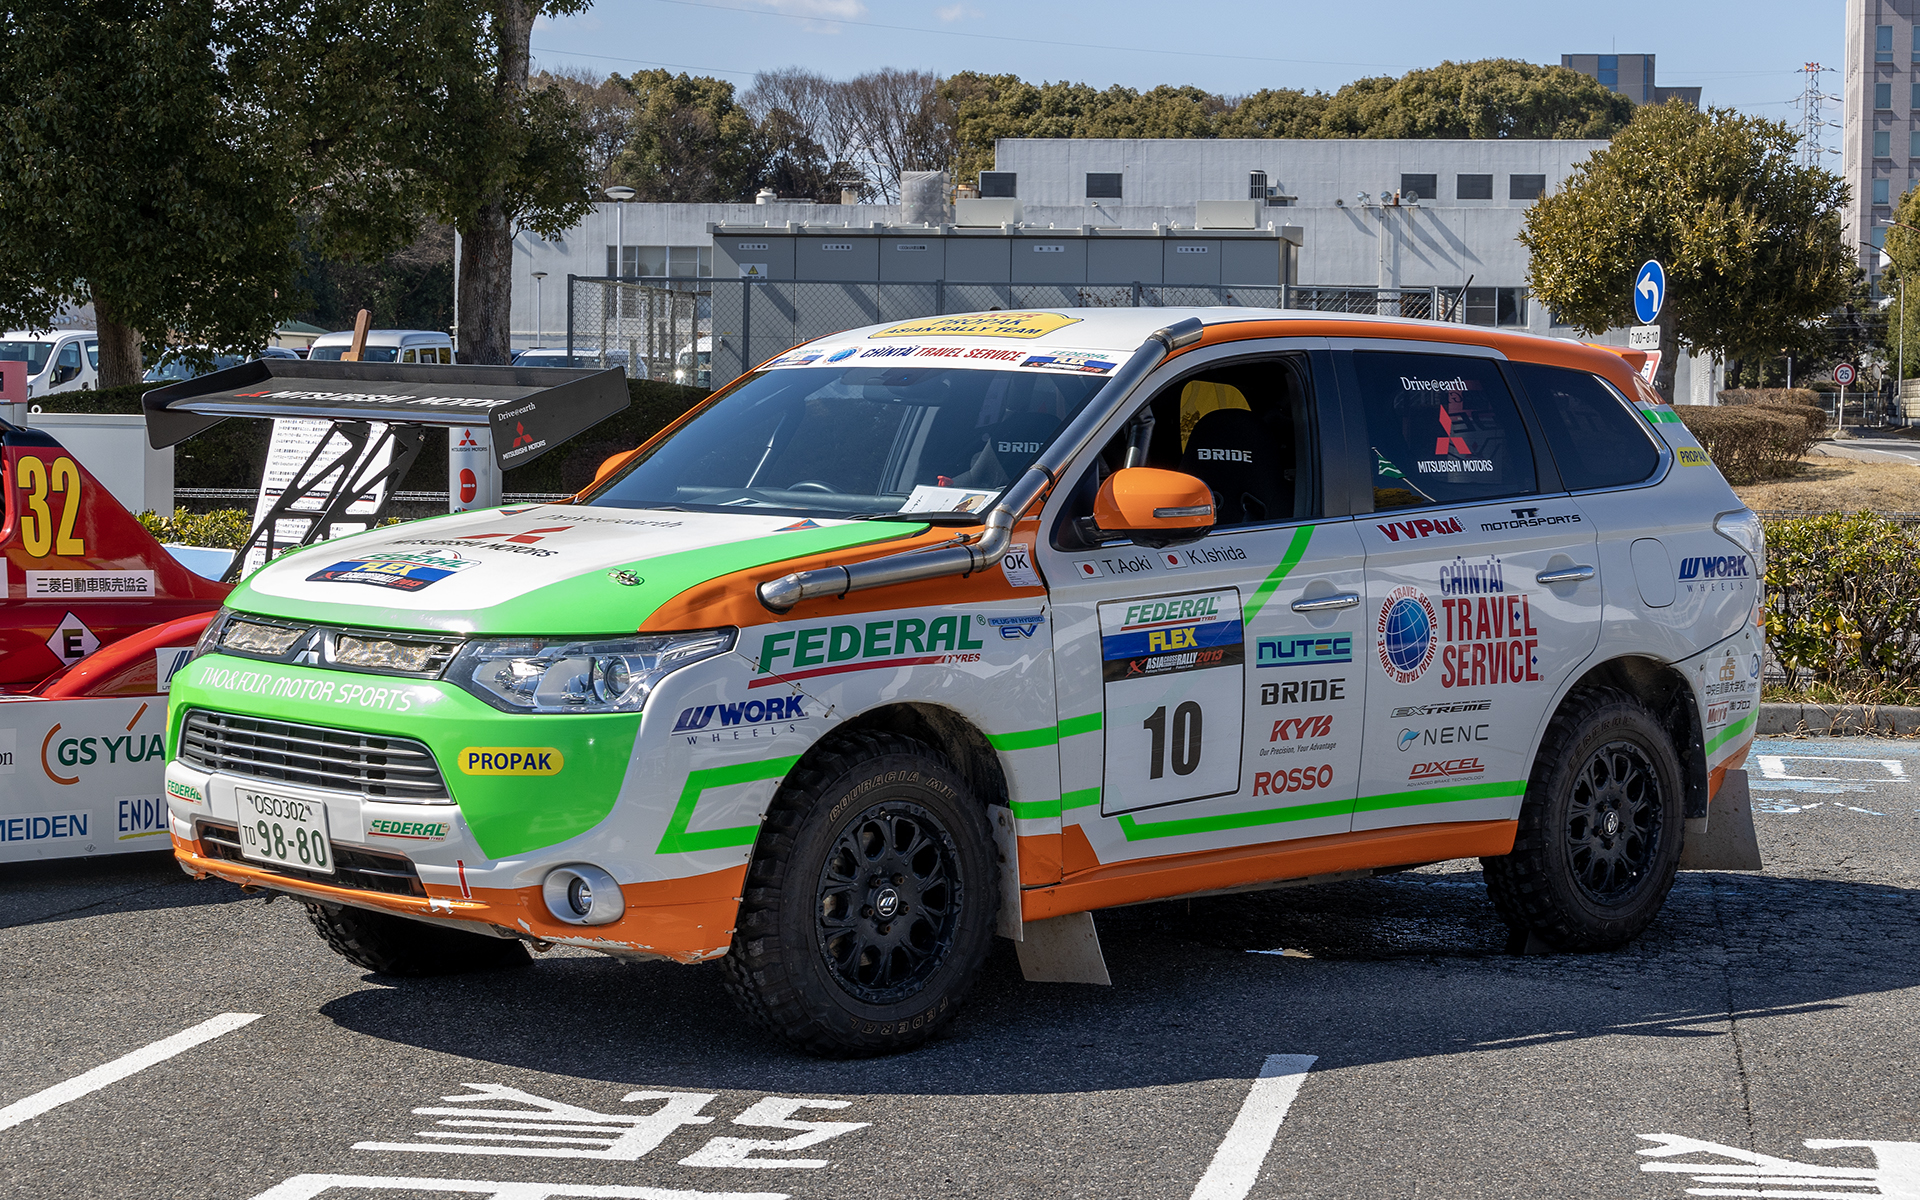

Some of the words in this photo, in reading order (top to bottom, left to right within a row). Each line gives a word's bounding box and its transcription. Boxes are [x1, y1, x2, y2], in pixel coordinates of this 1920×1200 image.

[885, 326, 937, 335] ASIAN
[937, 326, 991, 334] RALLY
[994, 326, 1043, 335] TEAM
[914, 347, 965, 358] TRAVEL
[963, 348, 1027, 361] SERVICE
[1400, 376, 1469, 391] Drive@earth
[1839, 369, 1851, 380] 25
[259, 390, 417, 404] MITSUBISHI
[407, 396, 512, 408] MOTOR
[497, 402, 536, 421] Drive@earth
[502, 446, 528, 460] MITSUBISHI
[527, 439, 547, 451] MOTORS
[998, 441, 1044, 453] BRID
[1197, 448, 1253, 463] BRIDE
[1680, 450, 1710, 463] PROPAK
[1417, 460, 1462, 473] MITSUBISHI
[1463, 459, 1494, 472] MOTORS
[17, 455, 86, 558] 32
[1480, 514, 1582, 532] MOTORSPORTS
[1004, 554, 1029, 569] OK
[1102, 555, 1153, 574] T.Aoki
[1185, 546, 1248, 564] K.Ishida
[352, 562, 423, 576] FLEX
[1702, 555, 1747, 578] WORK
[36, 576, 148, 594] 三菱自動車販売協会
[1686, 582, 1744, 592] WHEELS
[1124, 596, 1219, 625] FEDERAL
[1377, 595, 1396, 633] CHINTAI
[1393, 586, 1418, 600] TRAVEL
[1418, 592, 1438, 631] SERVICE
[1442, 594, 1538, 642] TRAVEL
[1001, 624, 1038, 638] EV
[1149, 627, 1198, 652] FLEX
[62, 628, 84, 658] E
[757, 615, 984, 674] FEDERAL
[1257, 637, 1352, 660] NUTEC
[947, 653, 981, 664] TYRES
[1146, 657, 1164, 670] ASIA
[1177, 652, 1199, 666] RALLY
[1197, 650, 1224, 663] 2013
[1377, 639, 1396, 678] SERVICE
[1419, 636, 1438, 675] CHINTAI
[1441, 639, 1540, 689] SERVICE
[1395, 669, 1420, 684] TRAVEL
[270, 676, 336, 702] MOTOR
[335, 683, 416, 712] SPORTS
[1260, 678, 1346, 706] BRIDE
[716, 694, 806, 727] WORK
[1390, 702, 1493, 718] EXTREME
[688, 724, 797, 745] WHEELS
[1269, 714, 1334, 742] KYB
[1424, 724, 1489, 746] NENC
[57, 737, 98, 766] GS
[101, 734, 166, 764] YUA
[1143, 700, 1203, 780] 10
[1260, 748, 1270, 756] Our
[1270, 746, 1296, 756] Precision,
[1297, 744, 1310, 753] Your
[1309, 742, 1337, 751] Advantage
[468, 752, 552, 770] PROPAK
[1410, 757, 1486, 777] DIXCEL
[1252, 764, 1334, 797] ROSSO
[1451, 775, 1485, 783] TECHNOLOGY
[167, 779, 202, 800] FEDERAL
[118, 798, 170, 832] ENDL
[0, 813, 88, 842] EIDEN
[371, 819, 446, 836] FEDERAL
[257, 820, 327, 867] 98-80
